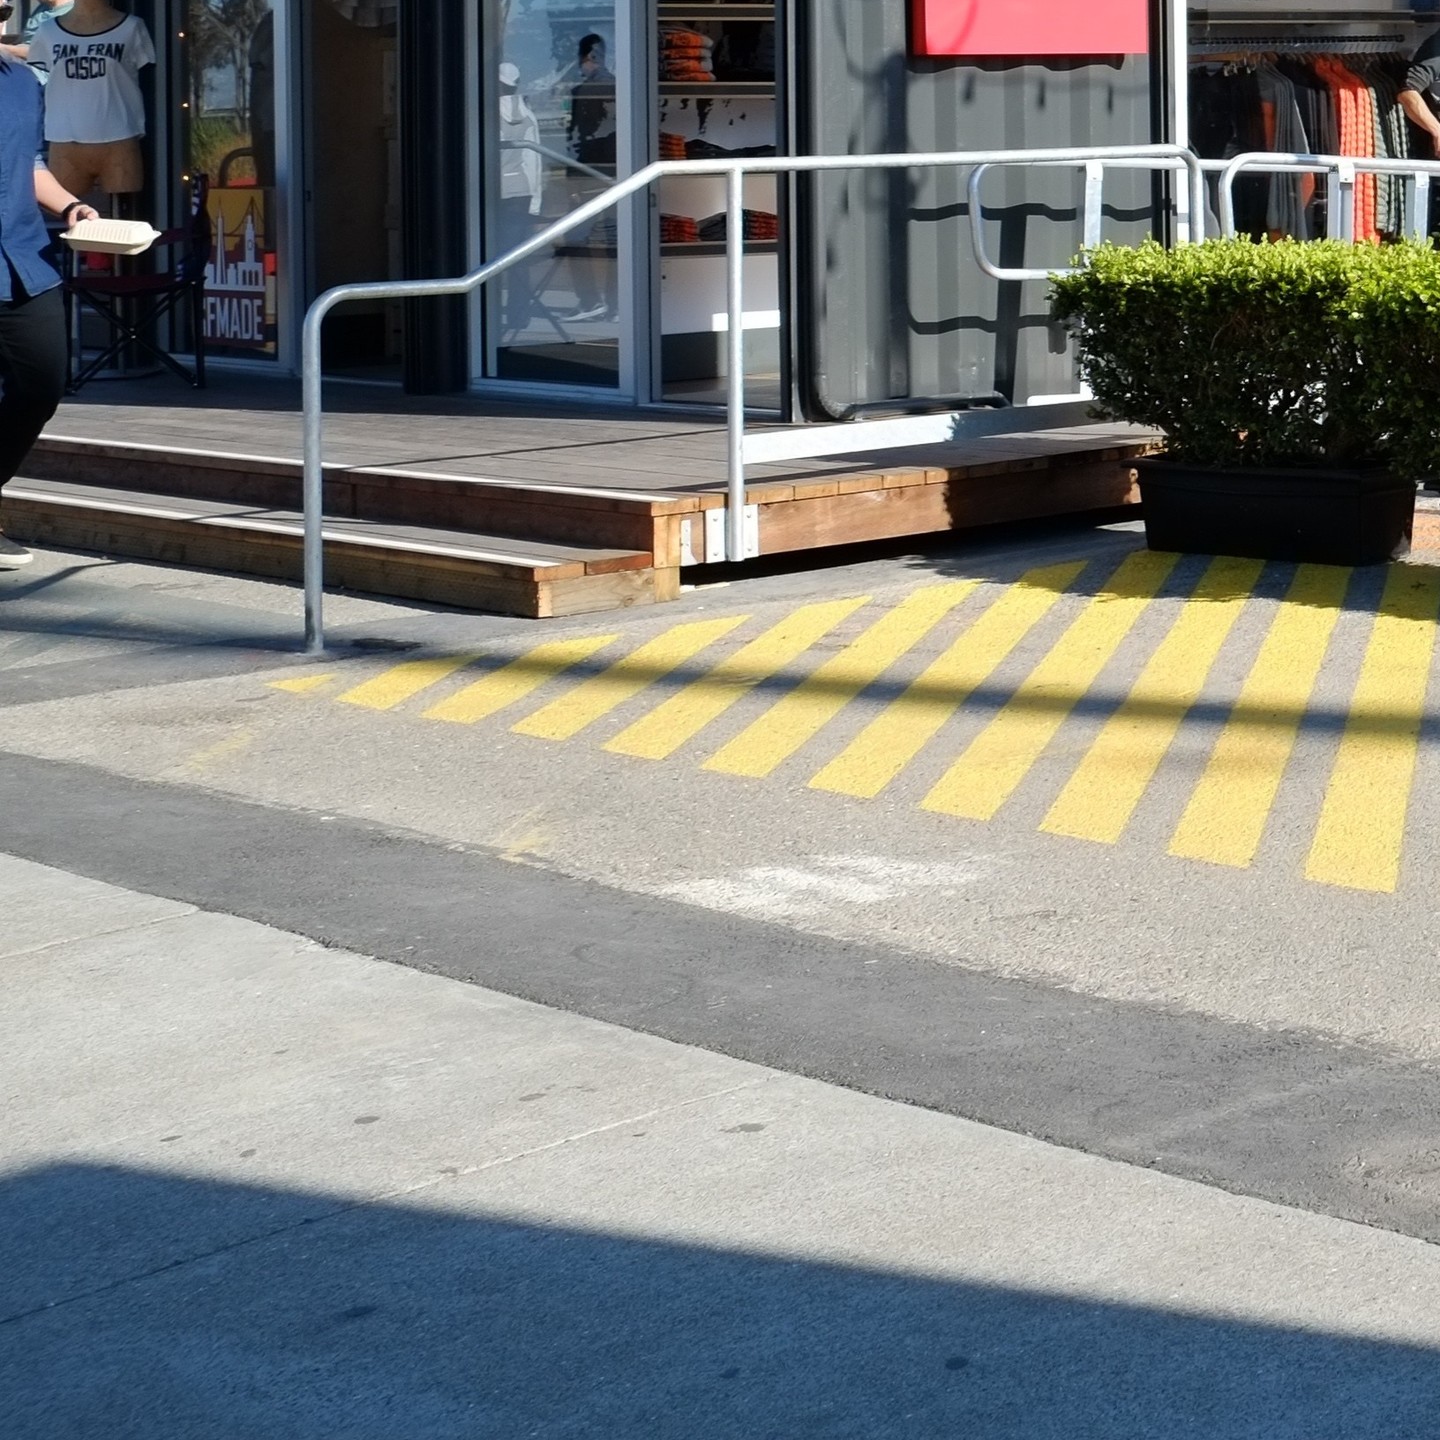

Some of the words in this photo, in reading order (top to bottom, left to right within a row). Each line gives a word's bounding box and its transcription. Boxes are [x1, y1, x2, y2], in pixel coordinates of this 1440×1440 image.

[53, 44, 78, 64] SAN
[87, 43, 125, 62] FRAN
[65, 57, 105, 79] CISCO
[203, 297, 263, 340] FMADE
